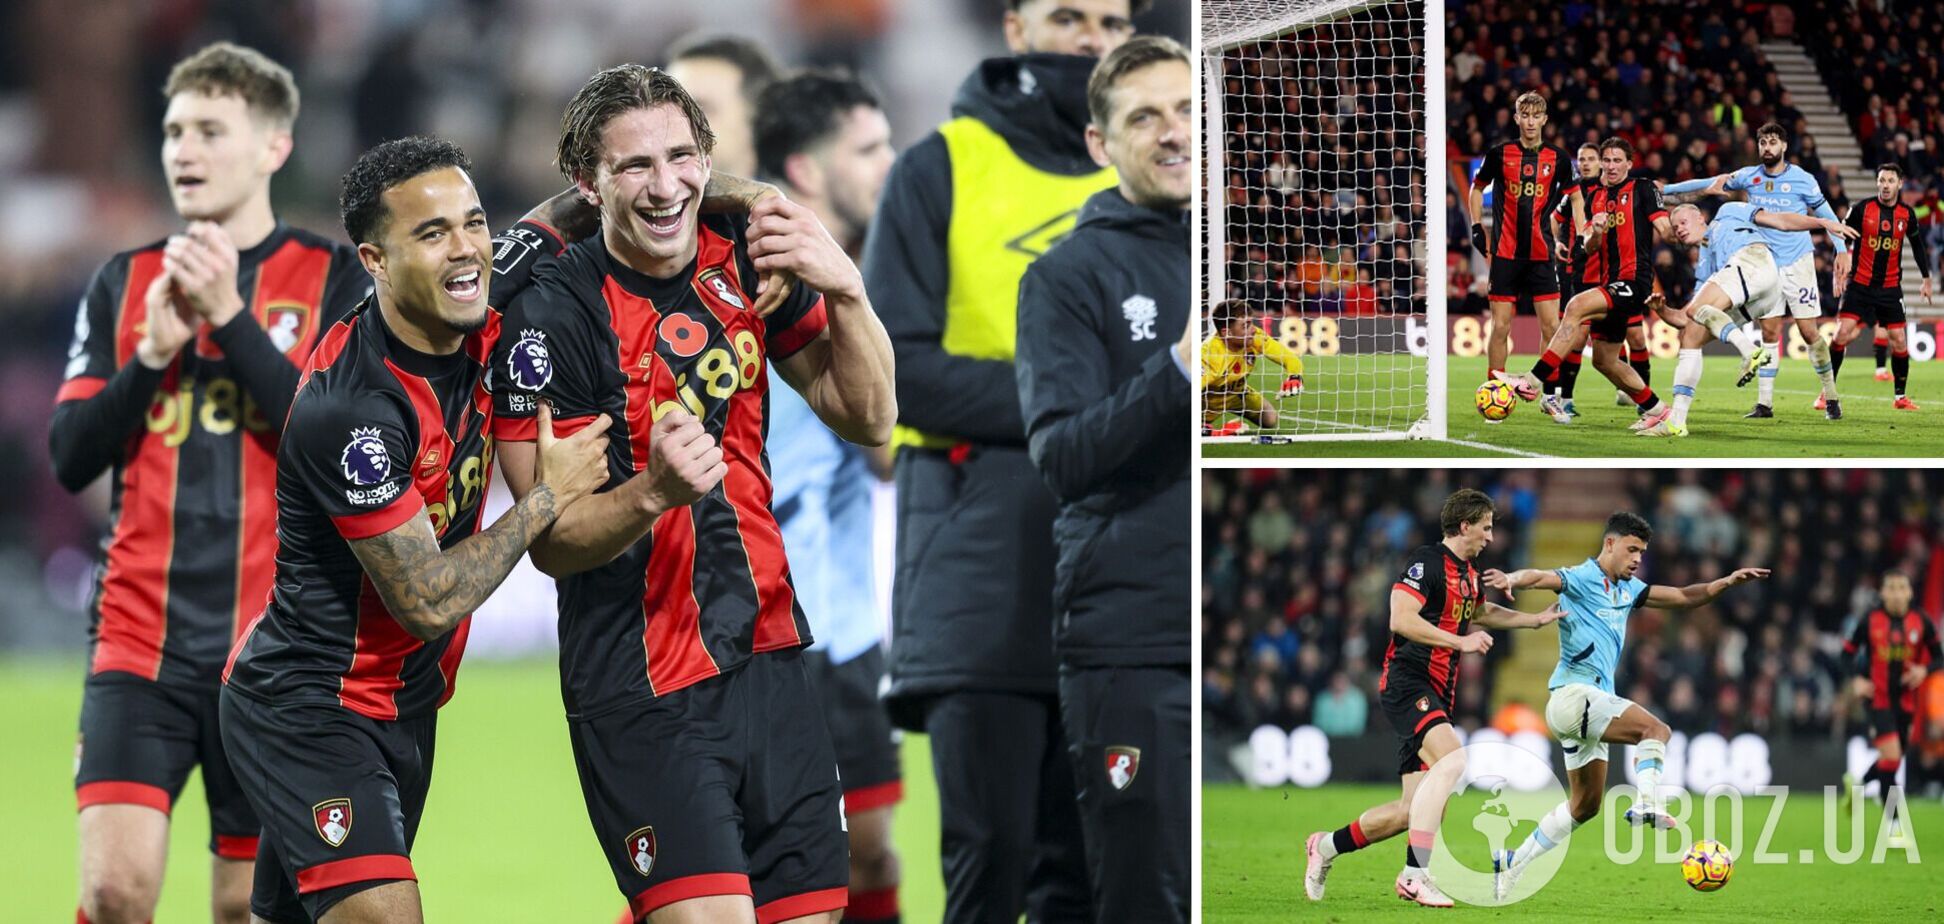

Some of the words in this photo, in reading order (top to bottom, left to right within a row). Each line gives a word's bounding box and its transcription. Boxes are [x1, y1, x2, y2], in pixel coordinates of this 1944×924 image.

[1508, 181, 1544, 198] bj88
[1751, 195, 1791, 207] TIHAD
[1868, 235, 1899, 251] bj88
[1799, 287, 1818, 304] 24
[1130, 320, 1157, 341] SC
[508, 392, 525, 404] No
[345, 489, 365, 500] No
[367, 480, 395, 498] room
[1452, 598, 1476, 623] bj8
